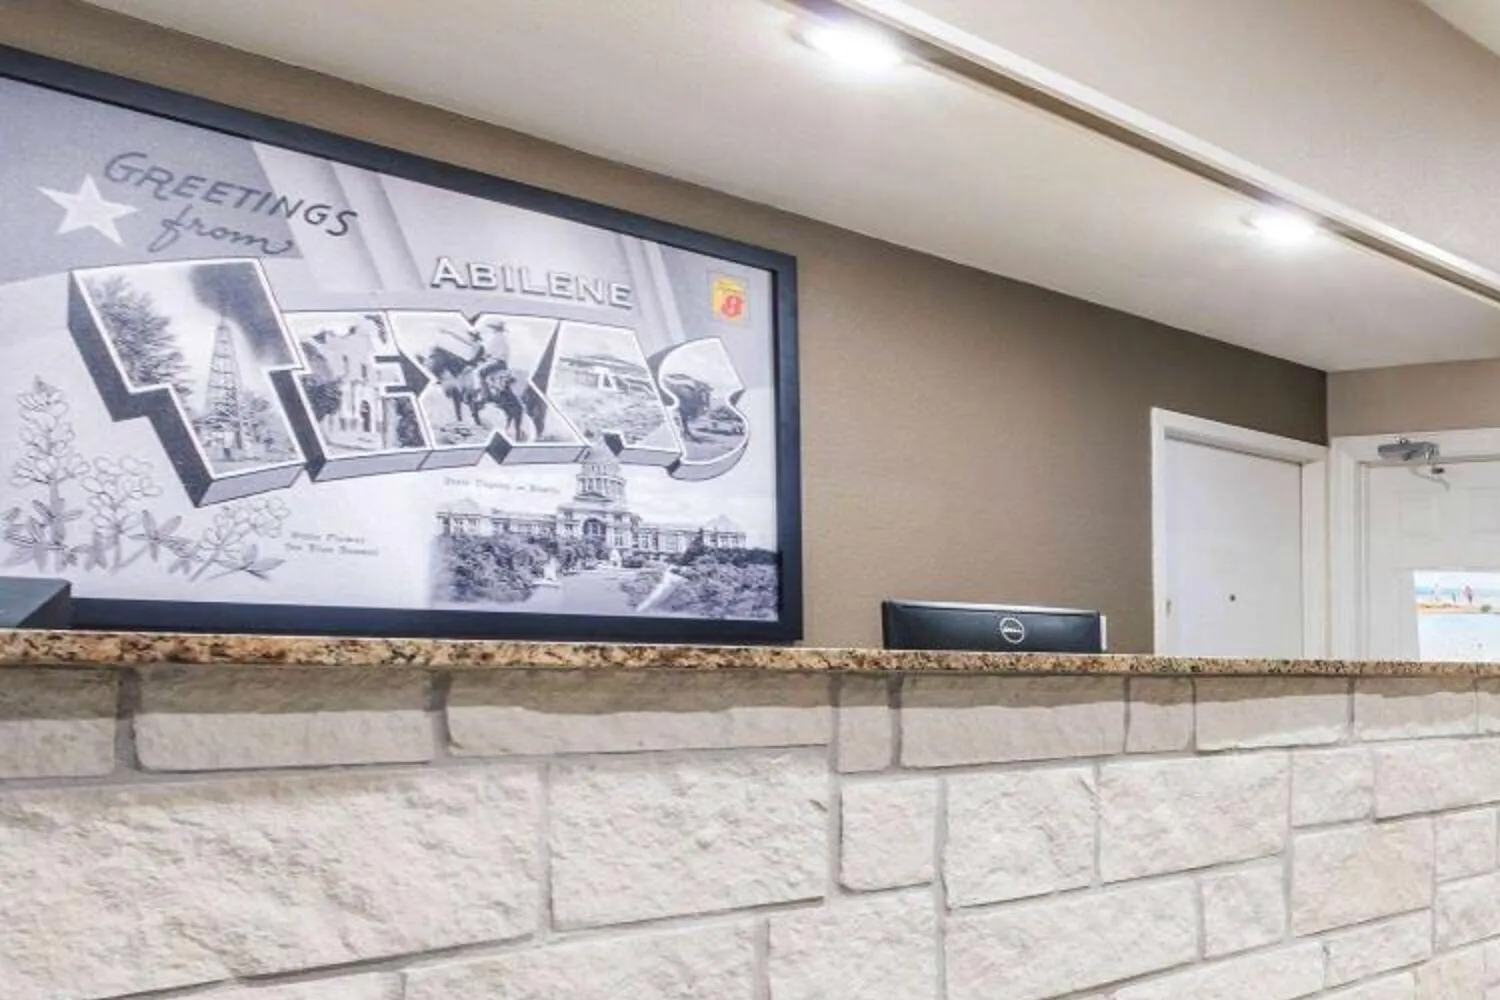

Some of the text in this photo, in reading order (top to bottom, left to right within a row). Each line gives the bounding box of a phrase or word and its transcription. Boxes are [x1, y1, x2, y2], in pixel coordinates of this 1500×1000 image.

[104, 152, 357, 236] GREETINGS
[148, 204, 294, 254] from
[430, 257, 633, 309] ABILENE
[68, 257, 749, 508] TEXAS
